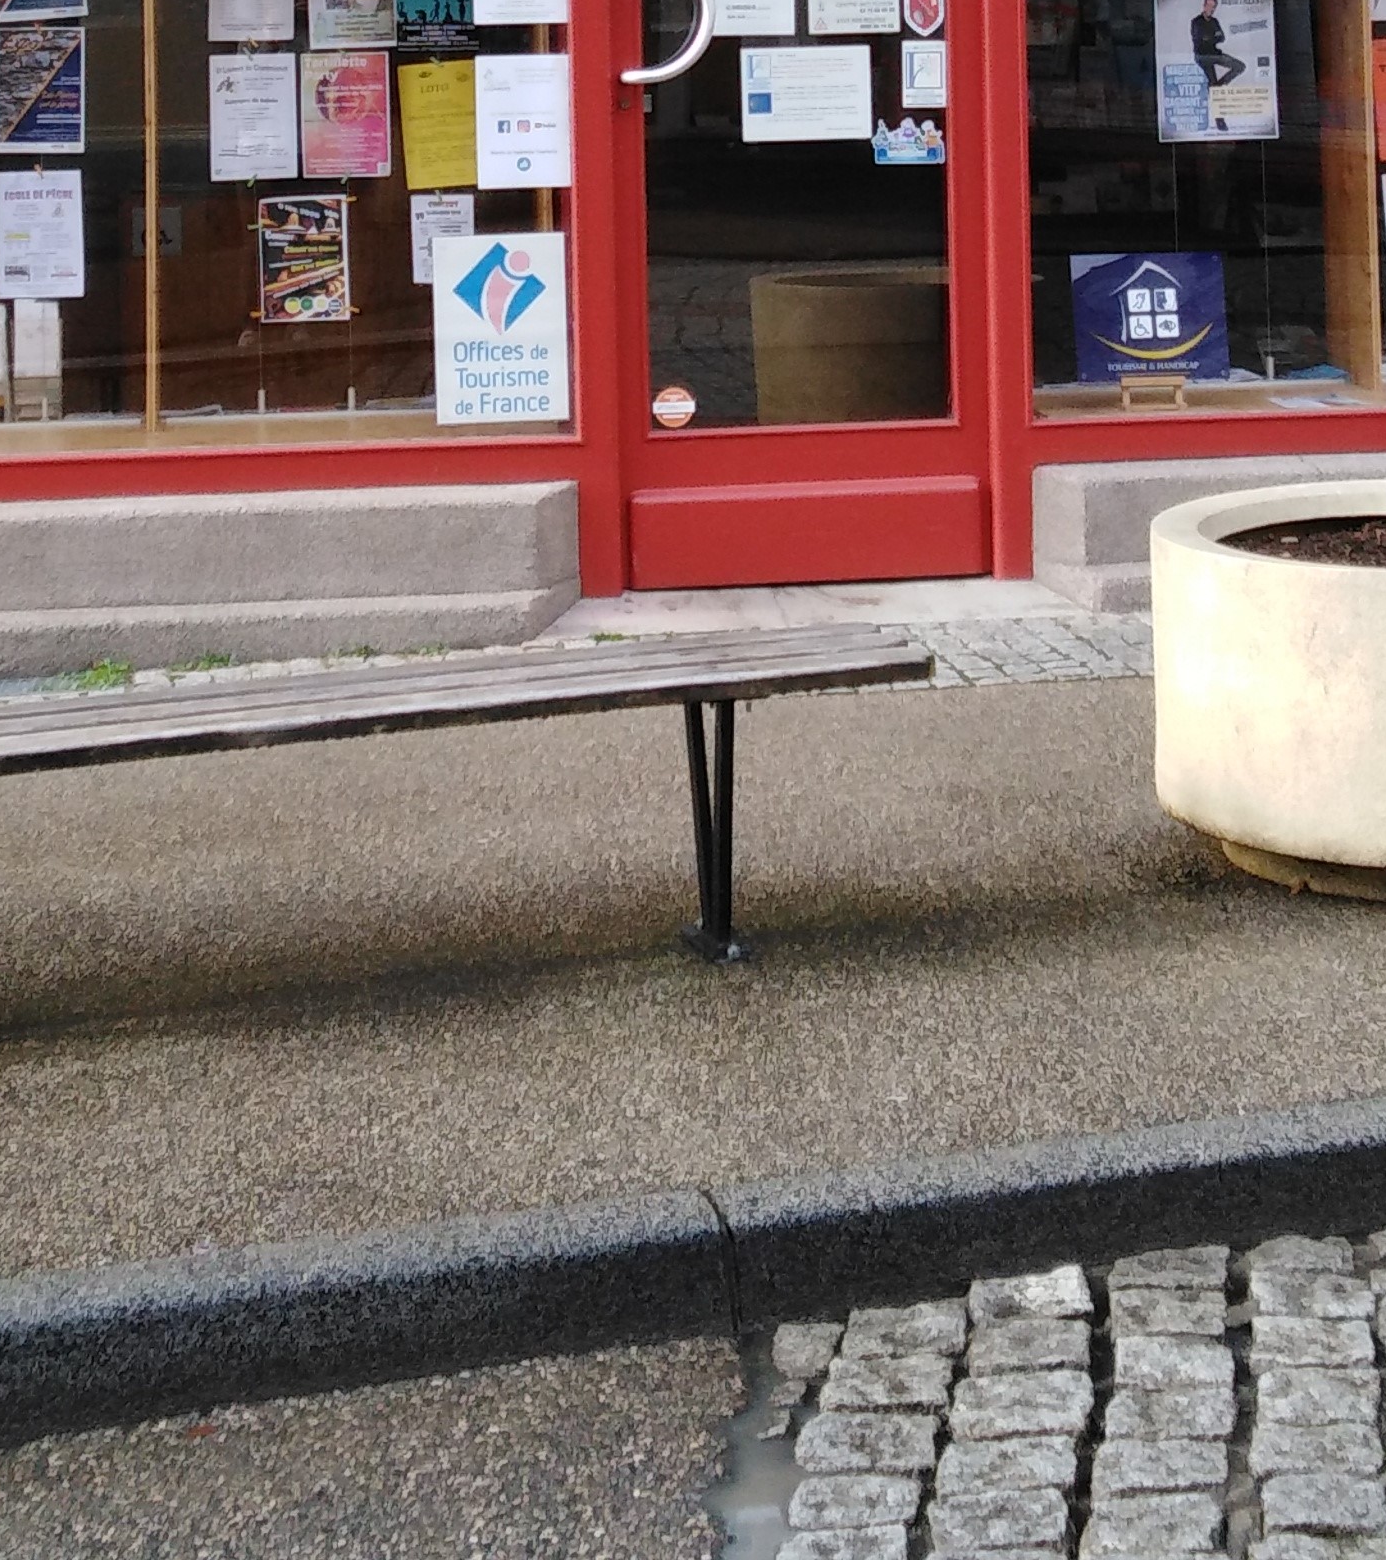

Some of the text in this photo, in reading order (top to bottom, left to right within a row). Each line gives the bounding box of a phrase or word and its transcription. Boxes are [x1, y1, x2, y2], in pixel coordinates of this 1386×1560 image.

[453, 340, 549, 363] Offices de
[454, 366, 550, 389] Tourisme
[1107, 362, 1148, 372] TOURISME
[1156, 361, 1200, 371] HANDICAP
[454, 392, 551, 415] de France
